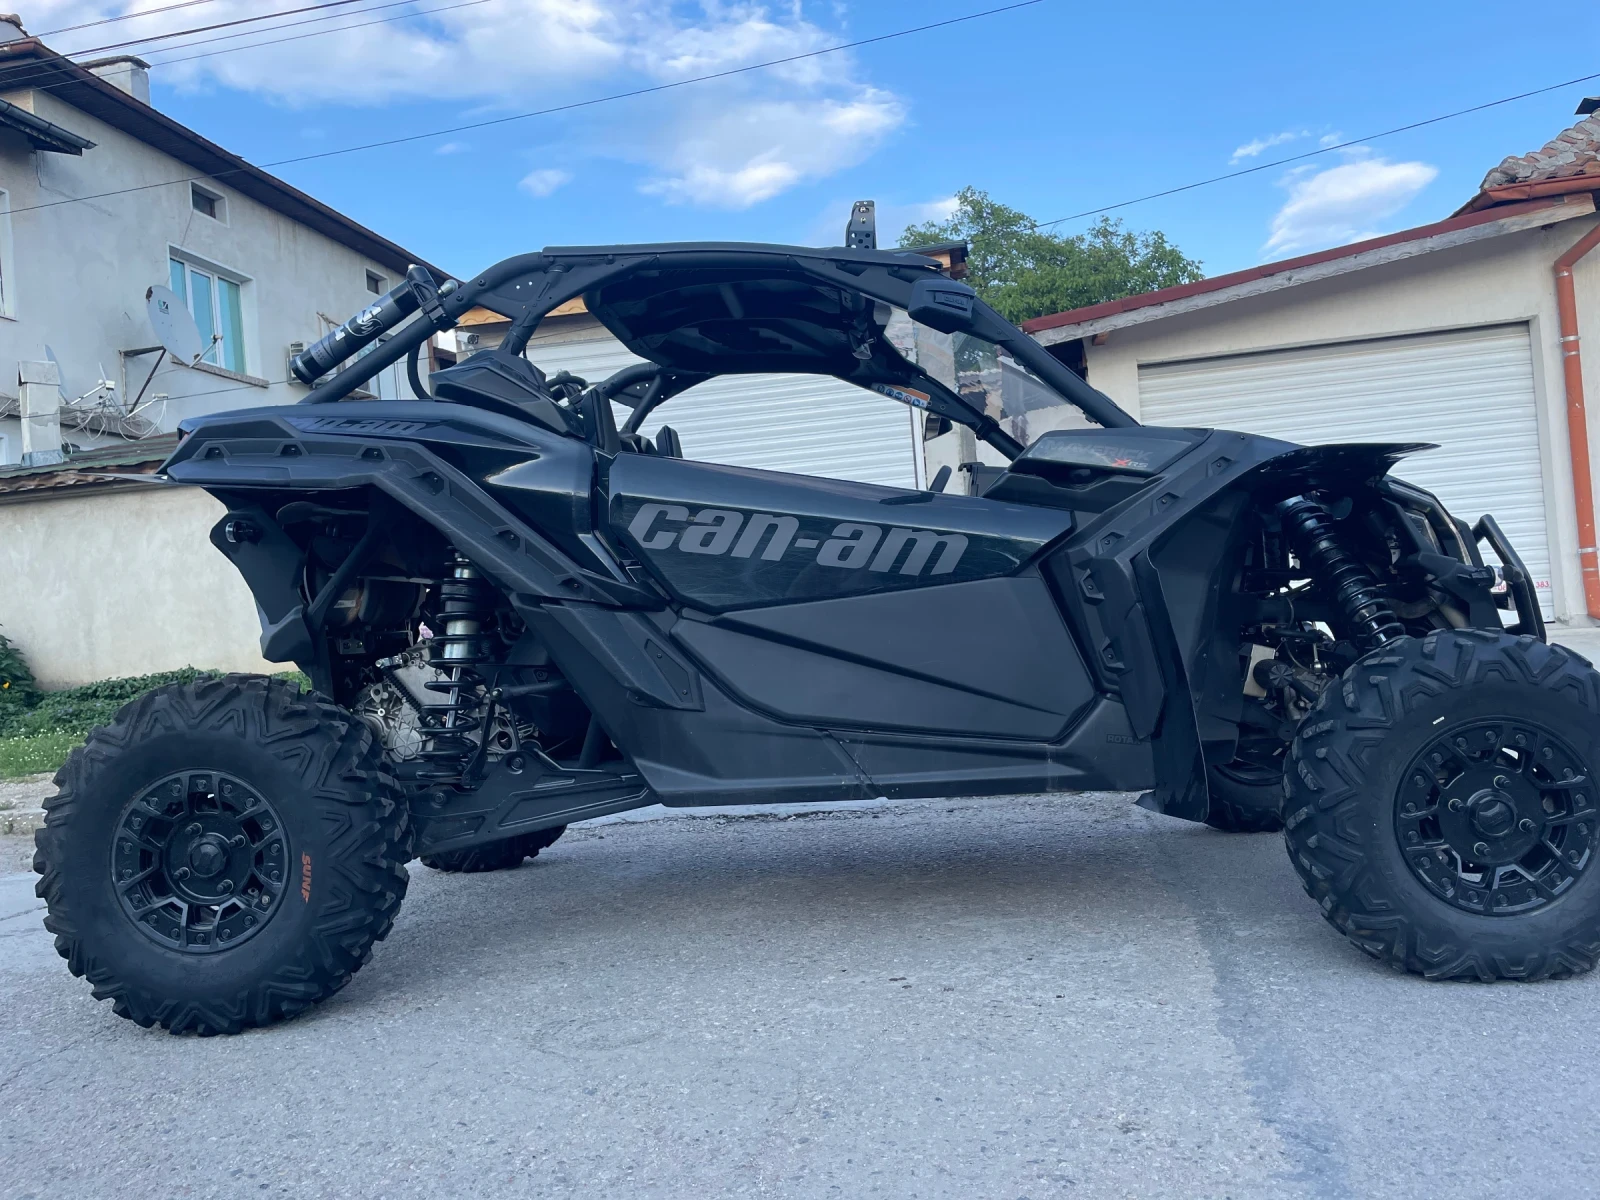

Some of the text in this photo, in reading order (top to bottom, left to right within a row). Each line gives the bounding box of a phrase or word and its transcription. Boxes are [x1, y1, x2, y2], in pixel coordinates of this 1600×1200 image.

[1045, 440, 1154, 460] MAVERICK
[628, 503, 968, 576] can-am
[301, 851, 312, 904] SUNF
